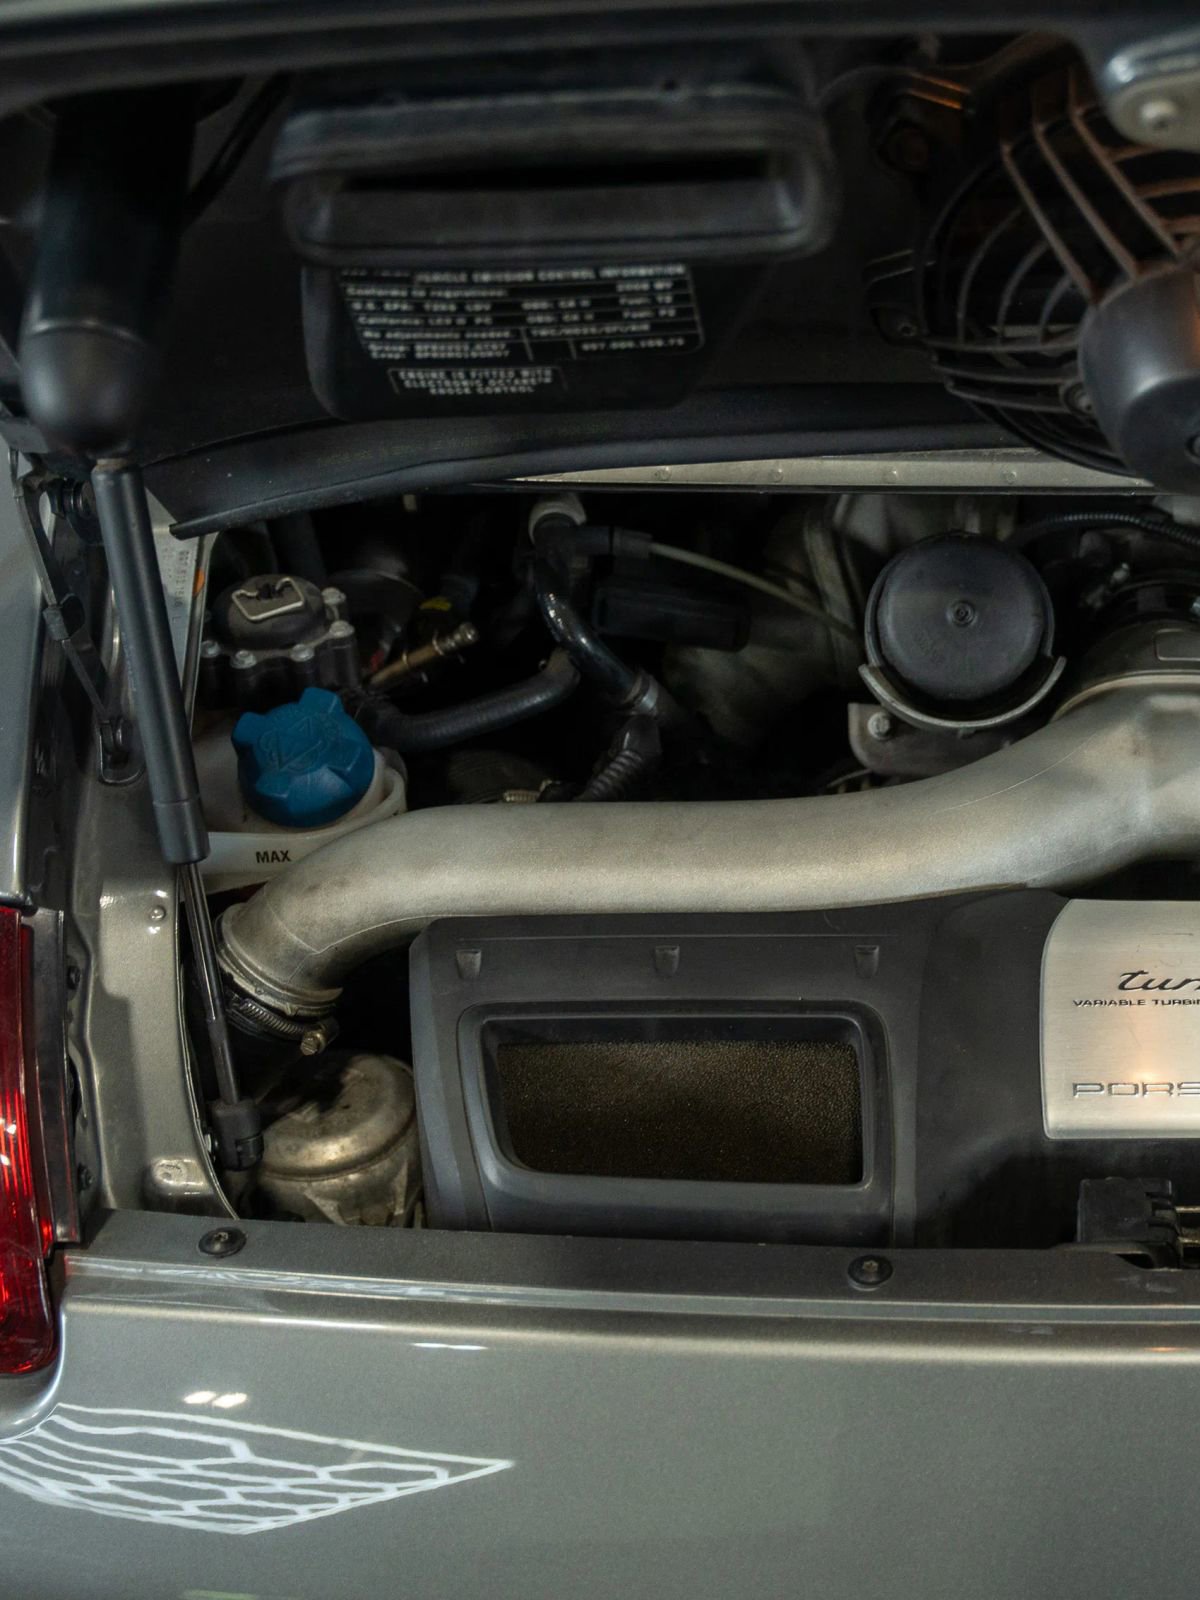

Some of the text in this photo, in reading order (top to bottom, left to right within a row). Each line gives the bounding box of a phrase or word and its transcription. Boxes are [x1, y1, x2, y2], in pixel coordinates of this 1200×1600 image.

[472, 270, 534, 283] EMISSION
[537, 268, 596, 281] CONTROL
[599, 264, 687, 278] INFORMATION
[255, 850, 292, 864] MAX
[1073, 999, 1146, 1007] VARIABLE
